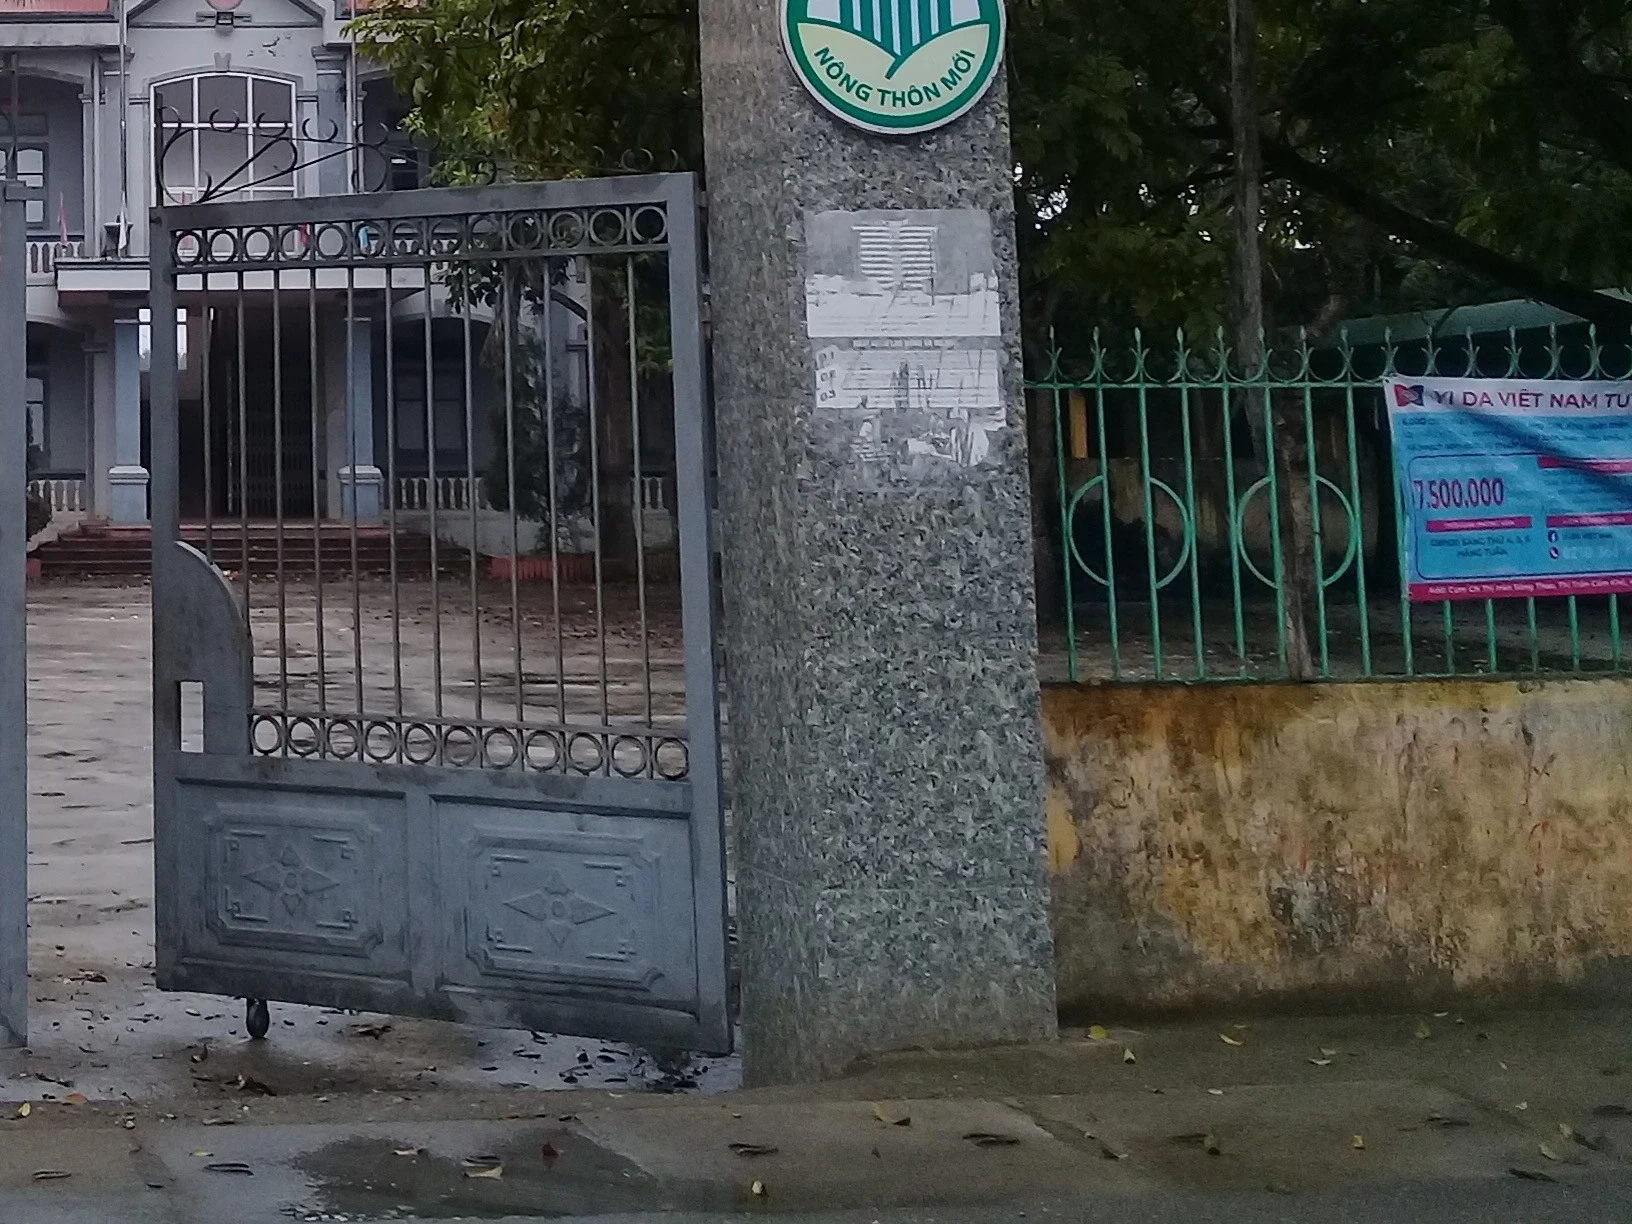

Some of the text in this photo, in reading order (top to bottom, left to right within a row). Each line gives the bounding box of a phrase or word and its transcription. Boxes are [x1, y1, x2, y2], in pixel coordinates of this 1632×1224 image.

[813, 46, 977, 108] NÔNG THÔN MỚI
[1462, 391, 1494, 408] DA
[1498, 388, 1544, 411] VIỆT
[1549, 392, 1598, 409] NAM
[1413, 477, 1505, 510] 7.500.000
